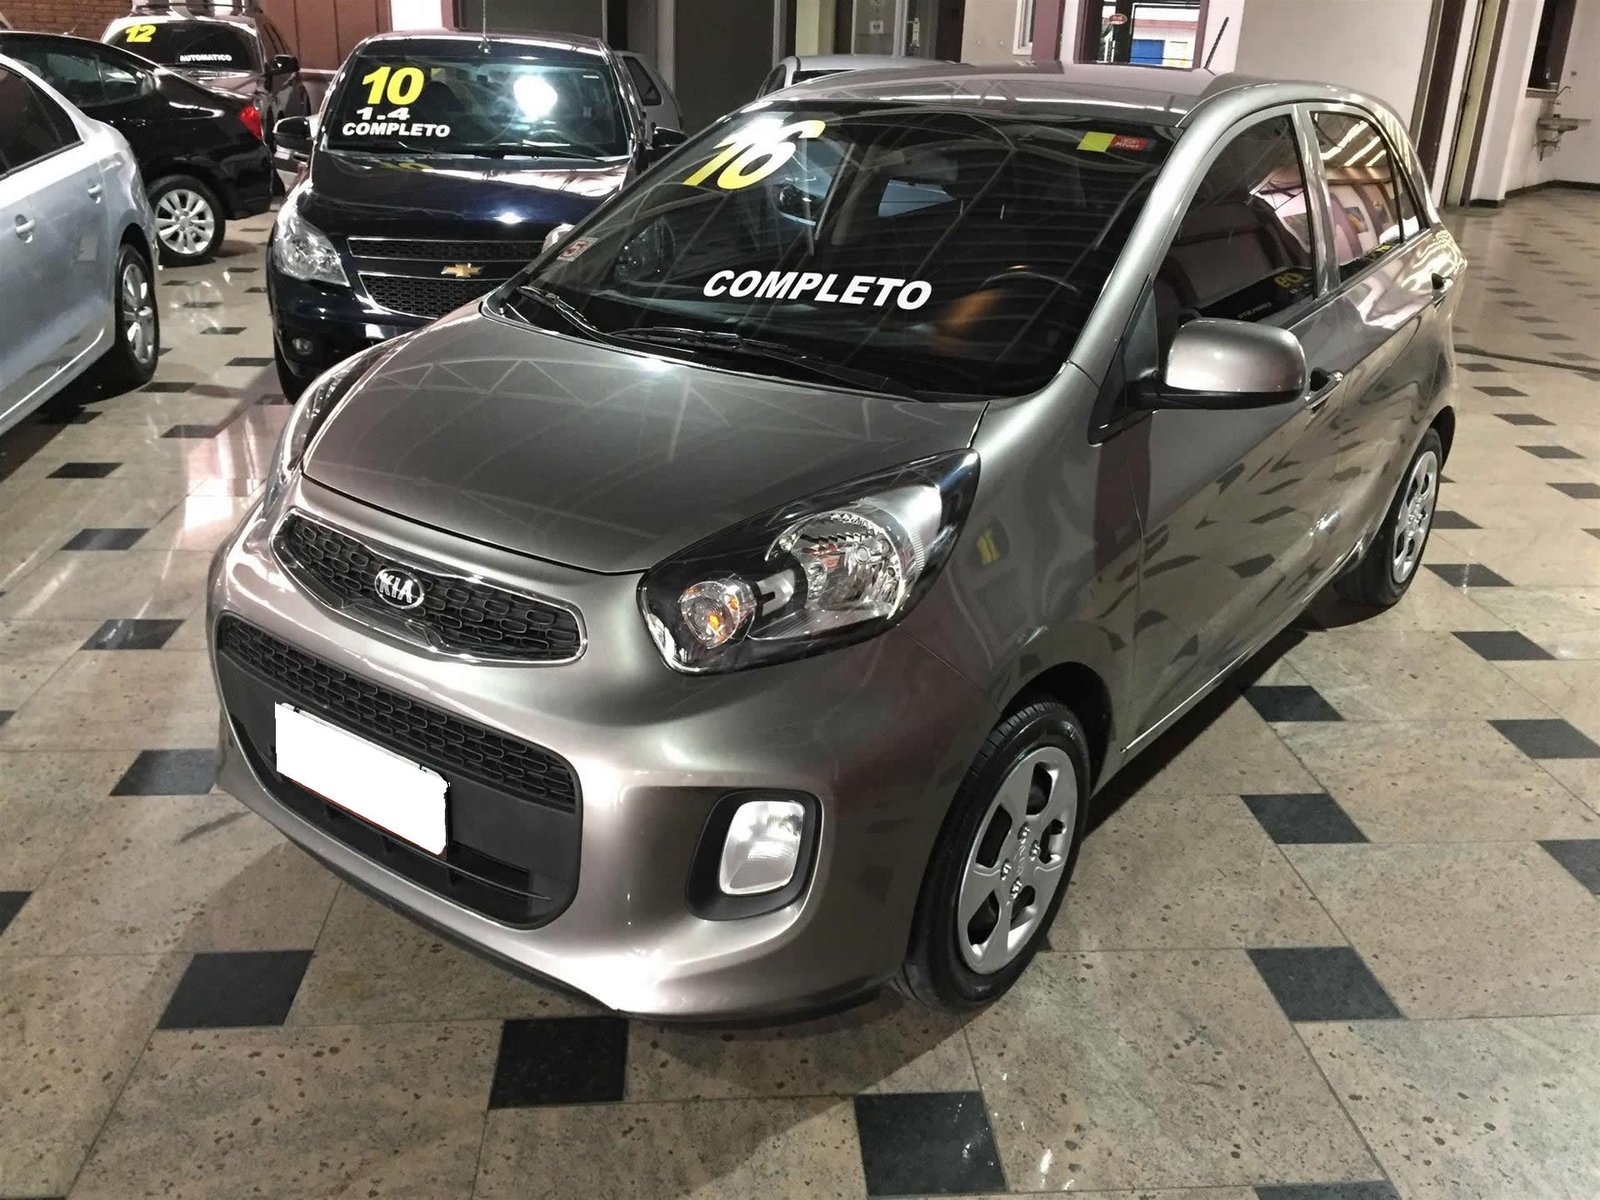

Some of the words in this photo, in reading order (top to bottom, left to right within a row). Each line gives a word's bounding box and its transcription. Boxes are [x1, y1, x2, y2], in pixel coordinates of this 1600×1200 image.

[125, 24, 157, 43] 12
[362, 66, 425, 105] 10
[342, 122, 451, 137] COMPLETO
[356, 106, 411, 120] 1.4
[682, 119, 826, 190] 16
[703, 270, 932, 310] COMPLETO
[378, 571, 415, 604] KIA
